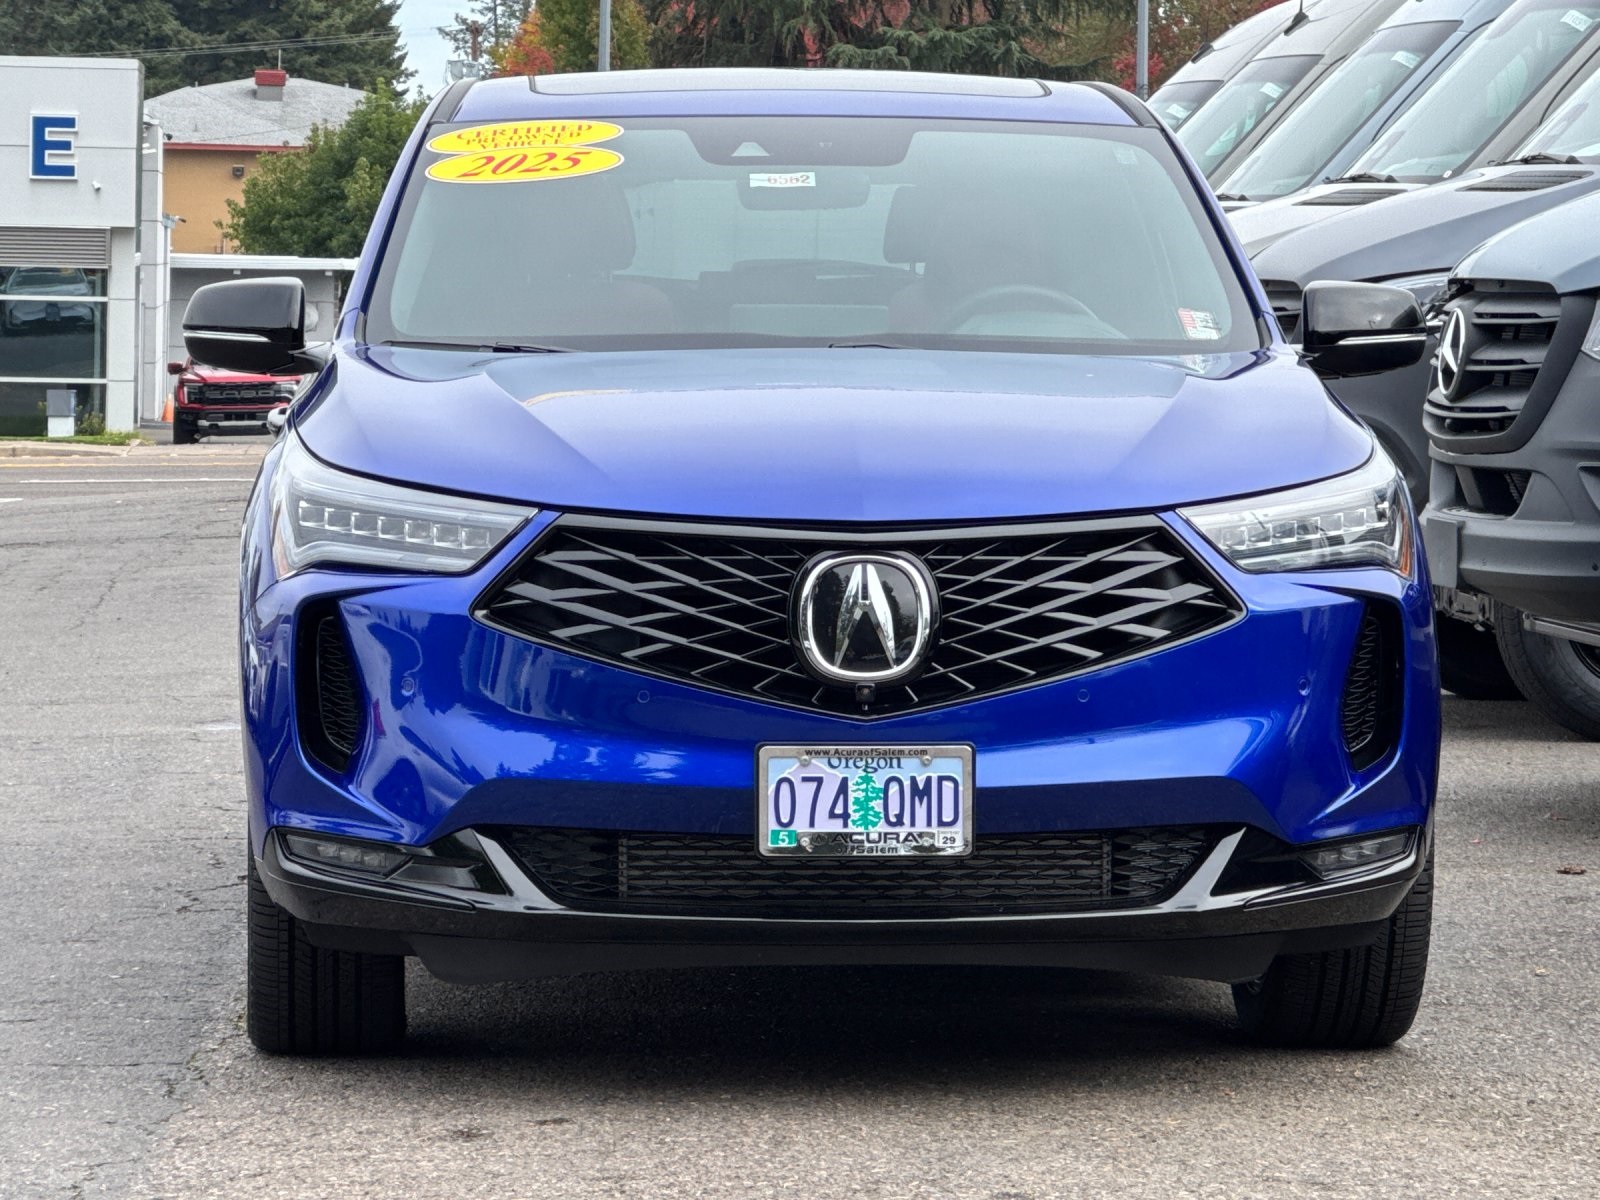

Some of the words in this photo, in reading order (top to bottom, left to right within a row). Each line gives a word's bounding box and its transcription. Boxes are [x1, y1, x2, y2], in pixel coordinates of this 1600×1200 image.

[456, 124, 593, 141] CERTIFIED
[30, 113, 78, 180] E
[480, 138, 564, 149] VEHICLE
[455, 151, 593, 178] 2025
[804, 748, 928, 756] www.AcuraofSalem.com
[827, 757, 903, 774] Oregon
[773, 776, 850, 829] 074
[882, 775, 960, 828] QMD
[778, 832, 789, 846] 5
[831, 832, 920, 845] ACURA
[941, 836, 956, 845] 29
[856, 846, 898, 854] Salem
